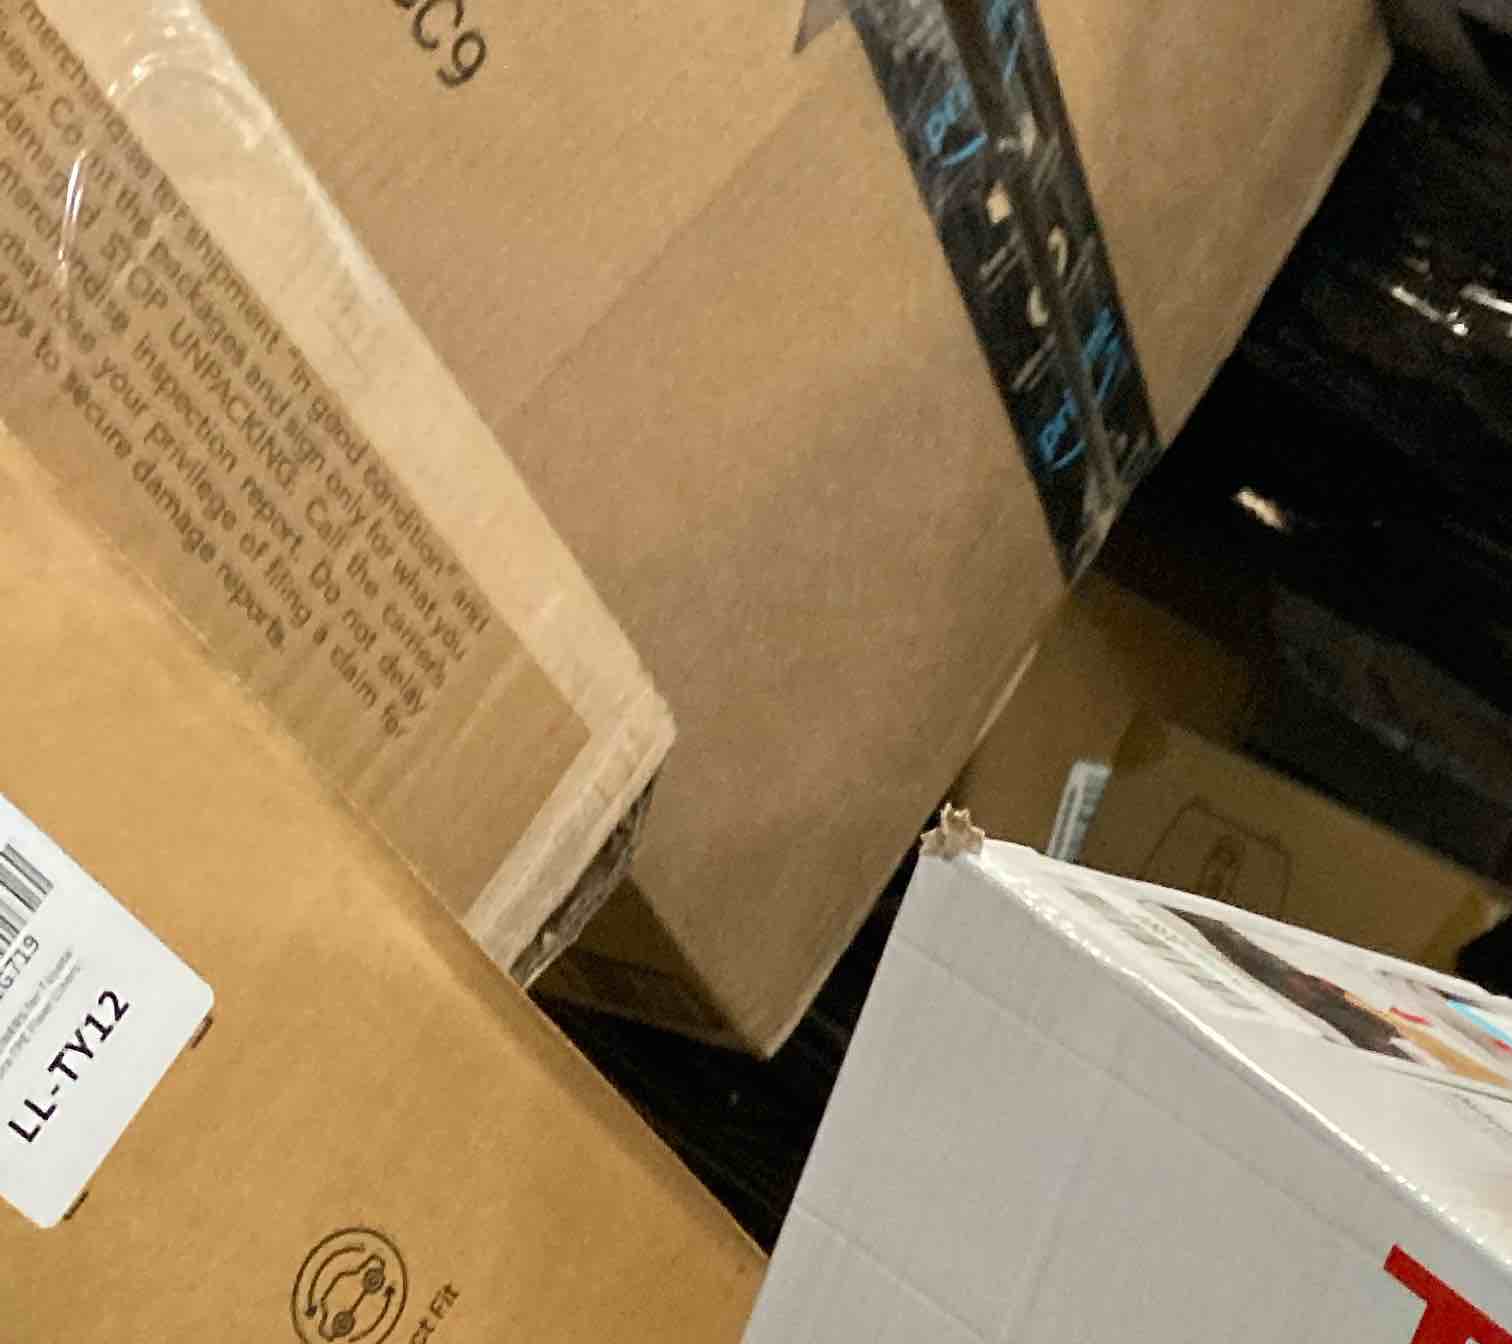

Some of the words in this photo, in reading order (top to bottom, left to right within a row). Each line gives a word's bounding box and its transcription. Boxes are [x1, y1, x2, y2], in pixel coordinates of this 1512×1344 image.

[392, 0, 487, 88] C9
[19, 0, 154, 178] merchandise
[179, 218, 287, 355] shipment
[308, 396, 371, 463] good
[454, 586, 491, 635] and
[35, 330, 60, 371] to
[65, 374, 133, 459] secure
[131, 450, 216, 560] damage
[116, 186, 152, 239] the
[146, 238, 243, 360] packages
[244, 362, 290, 414] and
[277, 412, 328, 482] sign
[320, 464, 373, 530] only
[364, 517, 400, 566] for
[388, 551, 443, 618] what
[428, 614, 469, 662] you
[169, 316, 297, 491] UNPACKING.
[305, 497, 351, 552] Call
[345, 551, 384, 599] the
[94, 356, 148, 427] your
[141, 420, 236, 536] privilege
[237, 529, 269, 562] of
[257, 551, 314, 630] filing
[311, 624, 329, 648] a
[328, 644, 381, 711] claim
[377, 704, 409, 739] for
[133, 332, 239, 471] inspection
[238, 475, 304, 563] report.
[307, 557, 344, 607] Do
[340, 605, 382, 652] not
[375, 649, 430, 716] delay
[7, 990, 130, 1143] LL-TY12
[430, 1282, 460, 1320] Fit
